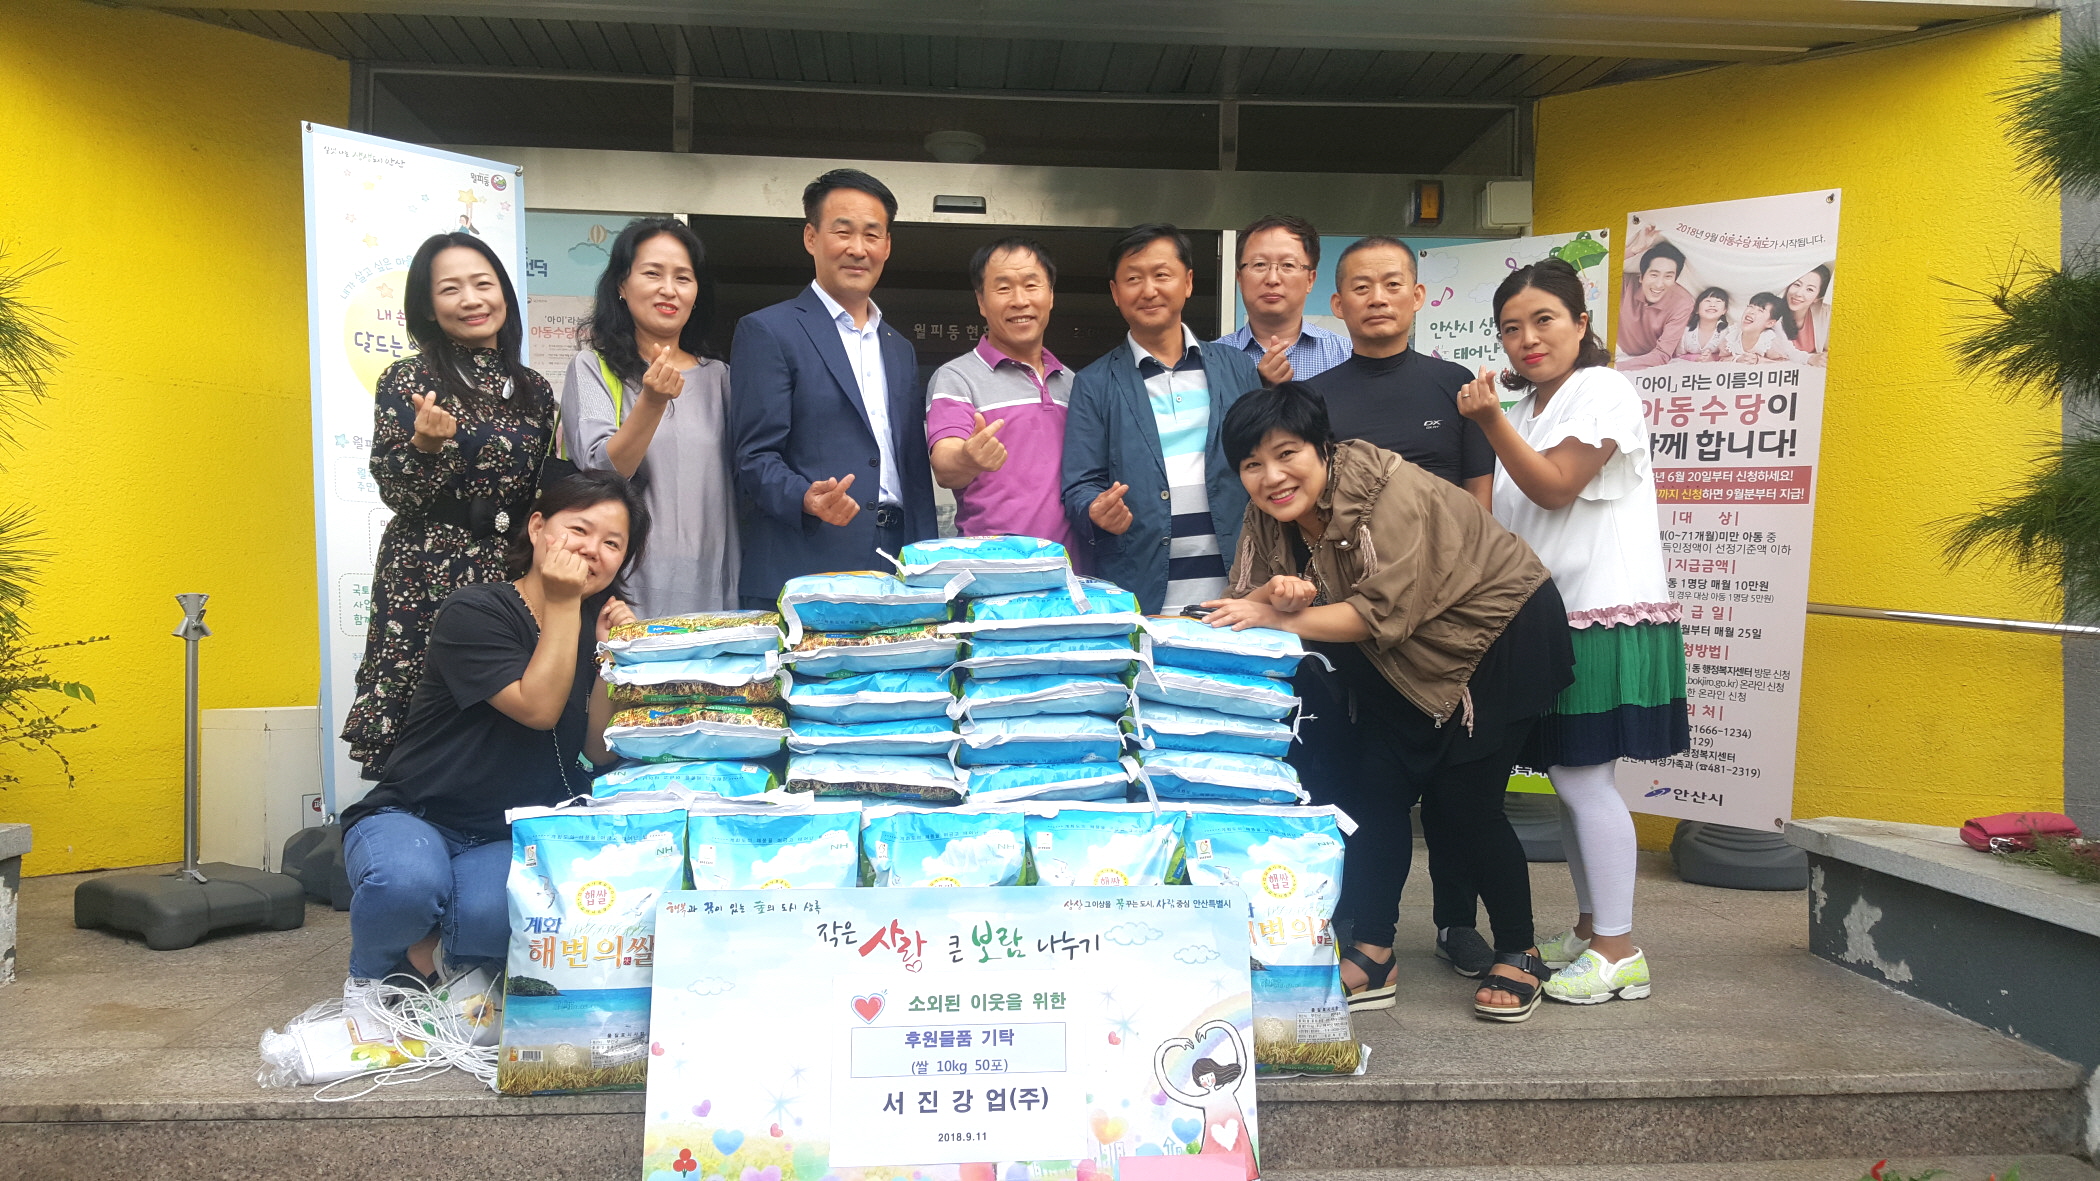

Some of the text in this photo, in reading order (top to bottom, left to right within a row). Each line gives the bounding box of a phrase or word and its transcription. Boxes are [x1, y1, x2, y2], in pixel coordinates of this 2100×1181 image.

[470, 172, 490, 188] 월피동
[1676, 222, 1826, 250] 2018년 9월 아동수당 제도가 시작됩니다.
[376, 308, 392, 320] 내
[1430, 318, 1474, 340] 안산시
[1454, 343, 1500, 362] 태어난
[1682, 374, 1712, 391] 라는
[1716, 371, 1763, 390] 이름의
[1768, 369, 1800, 387] 미래
[1642, 392, 1798, 428] 아동수당이
[1696, 428, 1797, 462] 합니다!
[1667, 472, 1685, 482] 6월
[1688, 470, 1733, 482] 20일부터
[1736, 470, 1794, 482] 신청하세요!
[1682, 488, 1724, 500] 신청하면
[1726, 488, 1776, 500] 9월분부터
[1779, 488, 1804, 500] 지급!
[1742, 532, 1763, 543] 아동
[1766, 532, 1777, 544] 중
[1716, 544, 1767, 555] 선정기준액
[1770, 544, 1792, 556] 이하
[352, 584, 370, 596] 국토
[1682, 578, 1708, 590] 1명당
[1710, 579, 1731, 590] 매월
[1734, 580, 1769, 592] 10만원
[1694, 592, 1710, 600] 대상
[1710, 593, 1726, 601] 아동
[1750, 594, 1774, 604] 5만원)
[1714, 626, 1734, 638] 매월
[1738, 628, 1762, 640] 25일
[1702, 664, 1753, 677] 행정복지센터
[1754, 668, 1772, 678] 방문
[1773, 669, 1790, 680] 신청
[1740, 680, 1766, 690] 온라인
[1766, 682, 1785, 692] 신청
[1698, 689, 1726, 700] 온라인
[1728, 692, 1747, 702] 신청
[1673, 788, 1724, 807] 안산시
[656, 846, 674, 856] NH
[830, 842, 848, 850] NH
[1268, 872, 1290, 890] 햅쌀
[584, 889, 608, 906] 햅쌀
[1063, 898, 1084, 910] 상상
[1126, 900, 1139, 908] 꾸는
[1156, 898, 1175, 909] 사람
[1176, 899, 1190, 908] 중심
[1192, 898, 1232, 909] 안산특별시
[730, 902, 746, 914] 있는
[781, 903, 797, 912] 도시
[523, 916, 562, 934] 계화
[816, 918, 1100, 974] 작은 사랑 큰 보람 나누기
[908, 992, 1067, 1013] 소외된 이웃을 위한
[904, 1028, 1014, 1049] 후원물품 기탁
[912, 1058, 1008, 1075] (쌀 10kg 50포)
[938, 1132, 987, 1142] 2018.9.11
